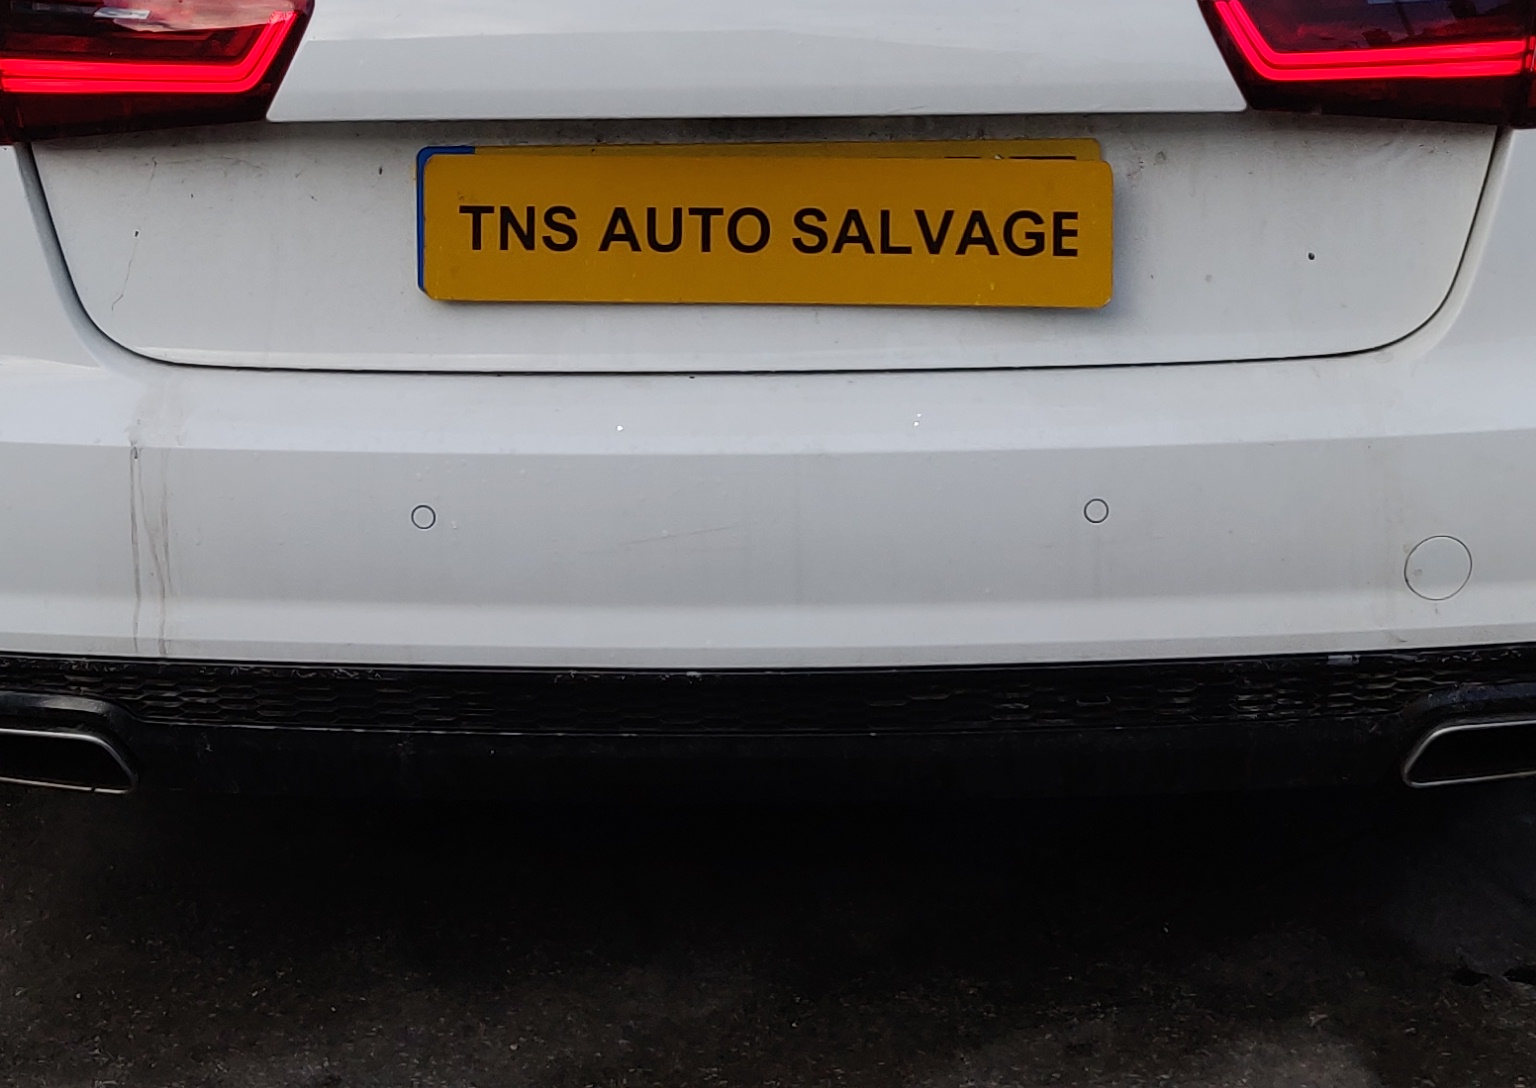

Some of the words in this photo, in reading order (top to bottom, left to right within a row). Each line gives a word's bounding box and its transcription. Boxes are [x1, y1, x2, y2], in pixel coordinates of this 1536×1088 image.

[459, 205, 577, 252] TNS
[598, 207, 771, 254] AUTO
[791, 208, 1078, 257] SALVAGE
